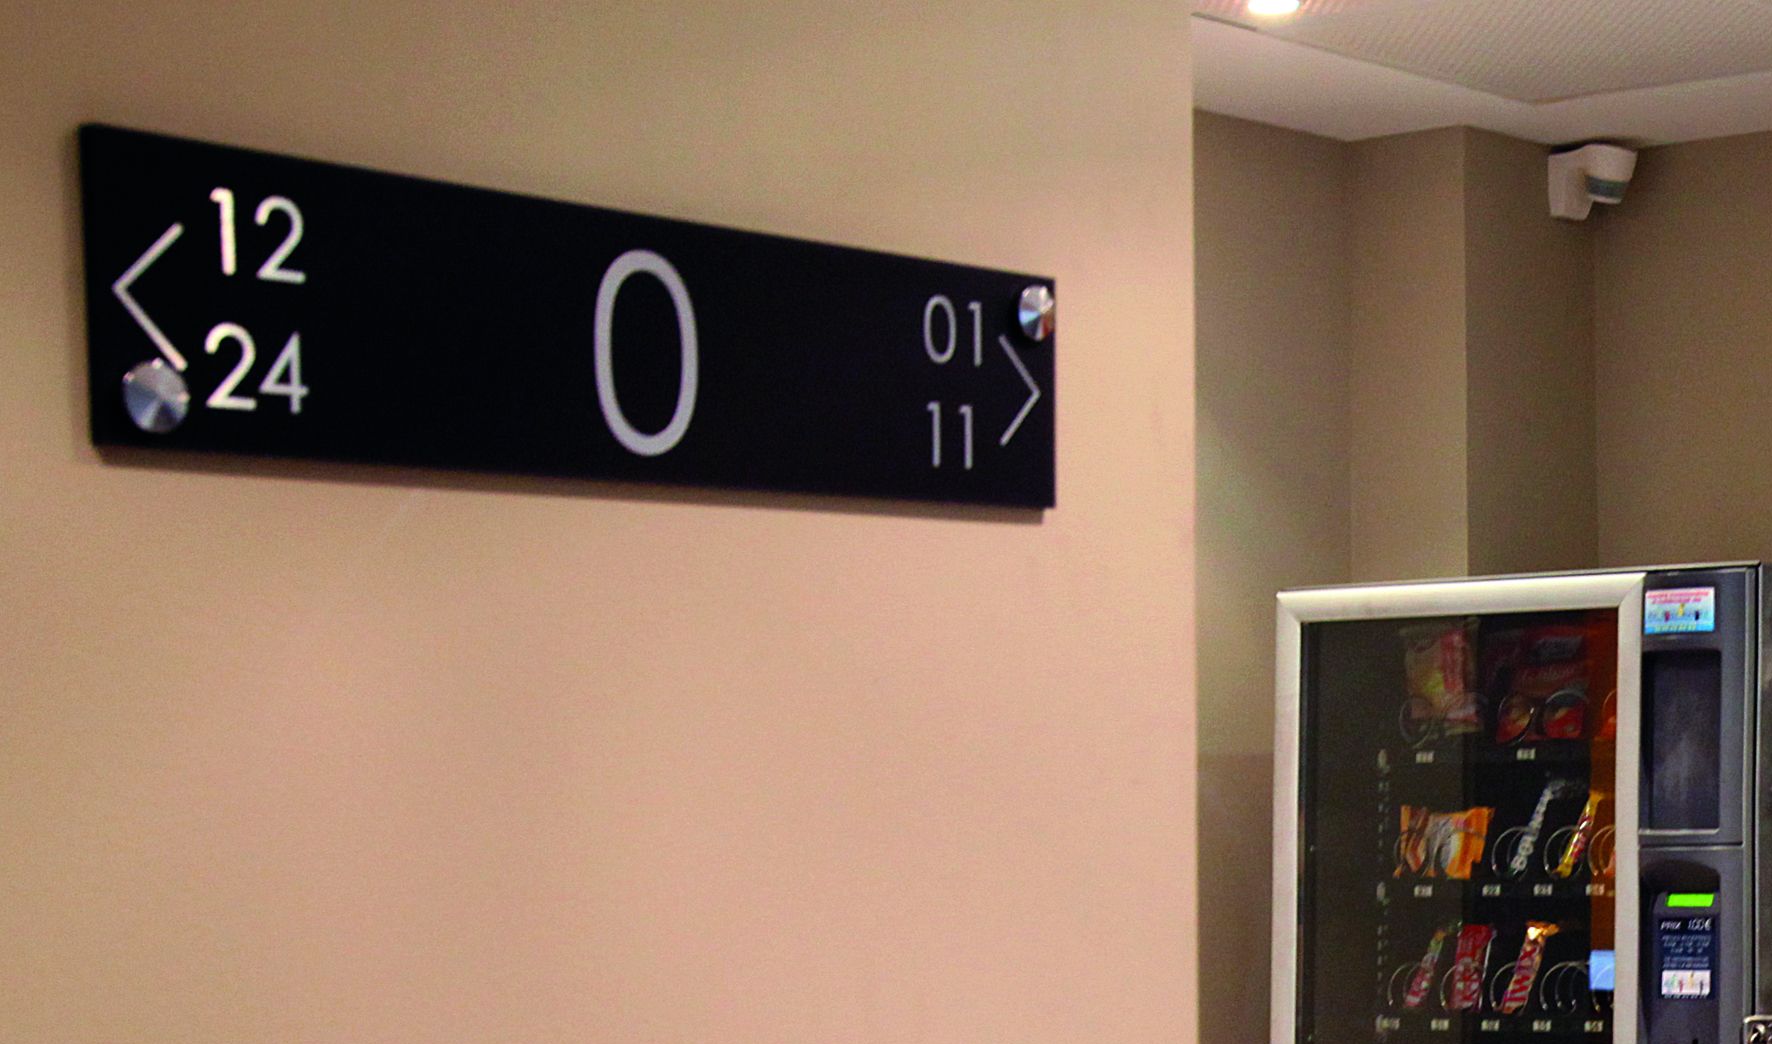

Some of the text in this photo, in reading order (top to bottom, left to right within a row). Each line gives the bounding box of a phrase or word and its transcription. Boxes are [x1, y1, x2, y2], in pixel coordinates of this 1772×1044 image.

[209, 187, 306, 284] 12
[204, 322, 310, 414] 24
[593, 249, 699, 456] 0
[923, 294, 983, 367] 01
[926, 401, 974, 470] 11
